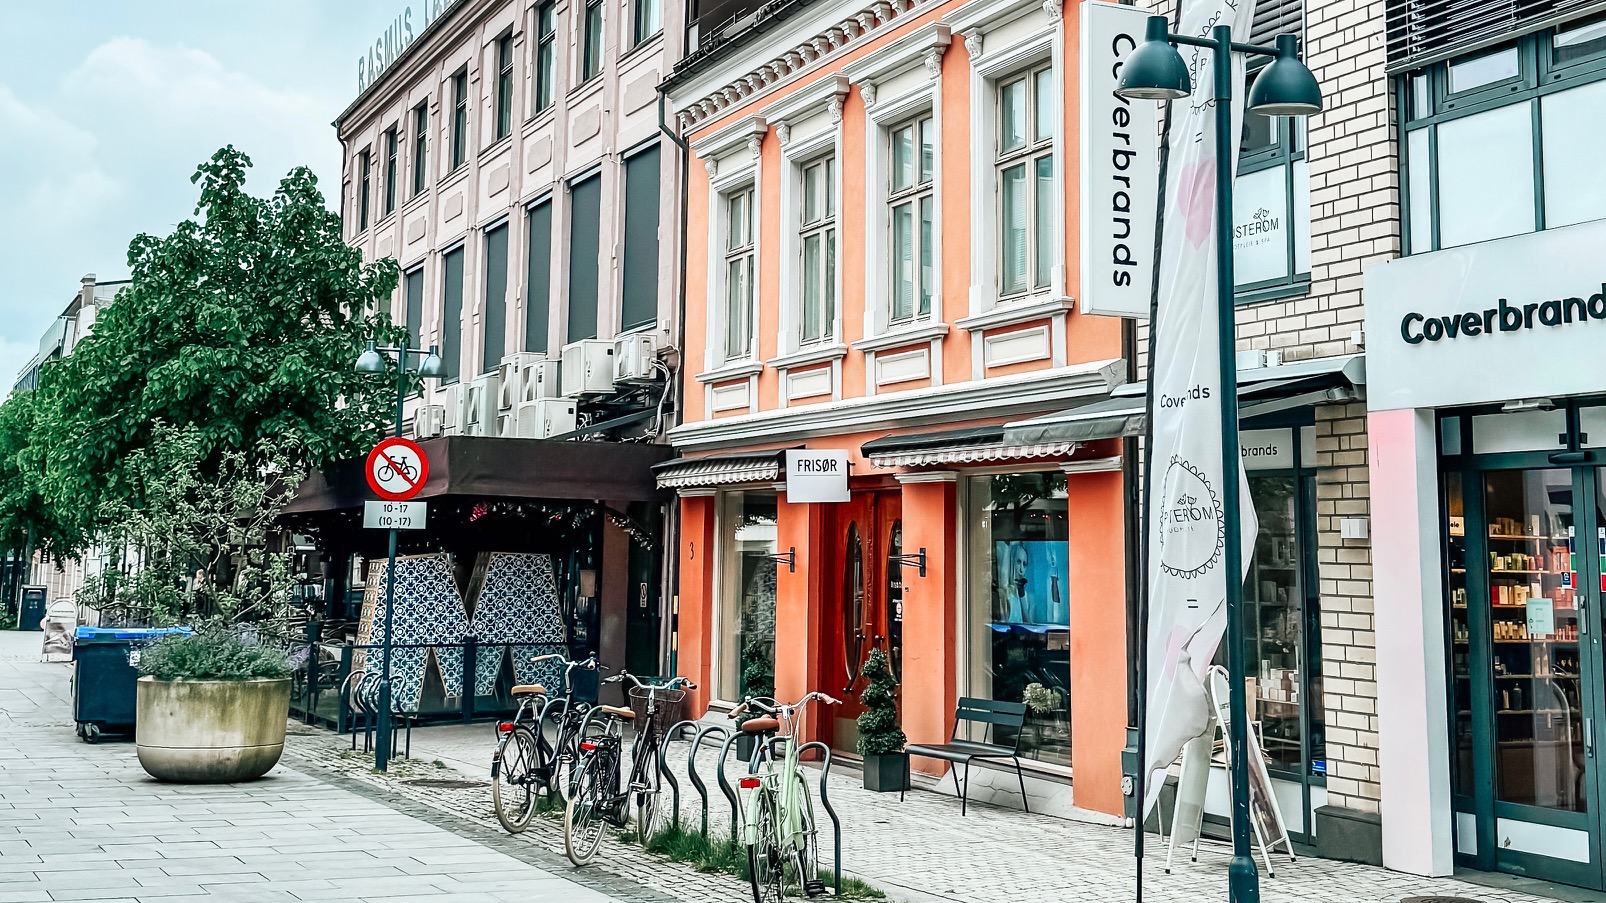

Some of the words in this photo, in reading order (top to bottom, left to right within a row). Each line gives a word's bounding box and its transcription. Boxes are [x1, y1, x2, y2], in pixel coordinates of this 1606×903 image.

[358, 6, 413, 94] RASMUS
[1232, 217, 1279, 239] STEROM
[797, 458, 838, 472] FRISØR
[689, 541, 695, 560] 3
